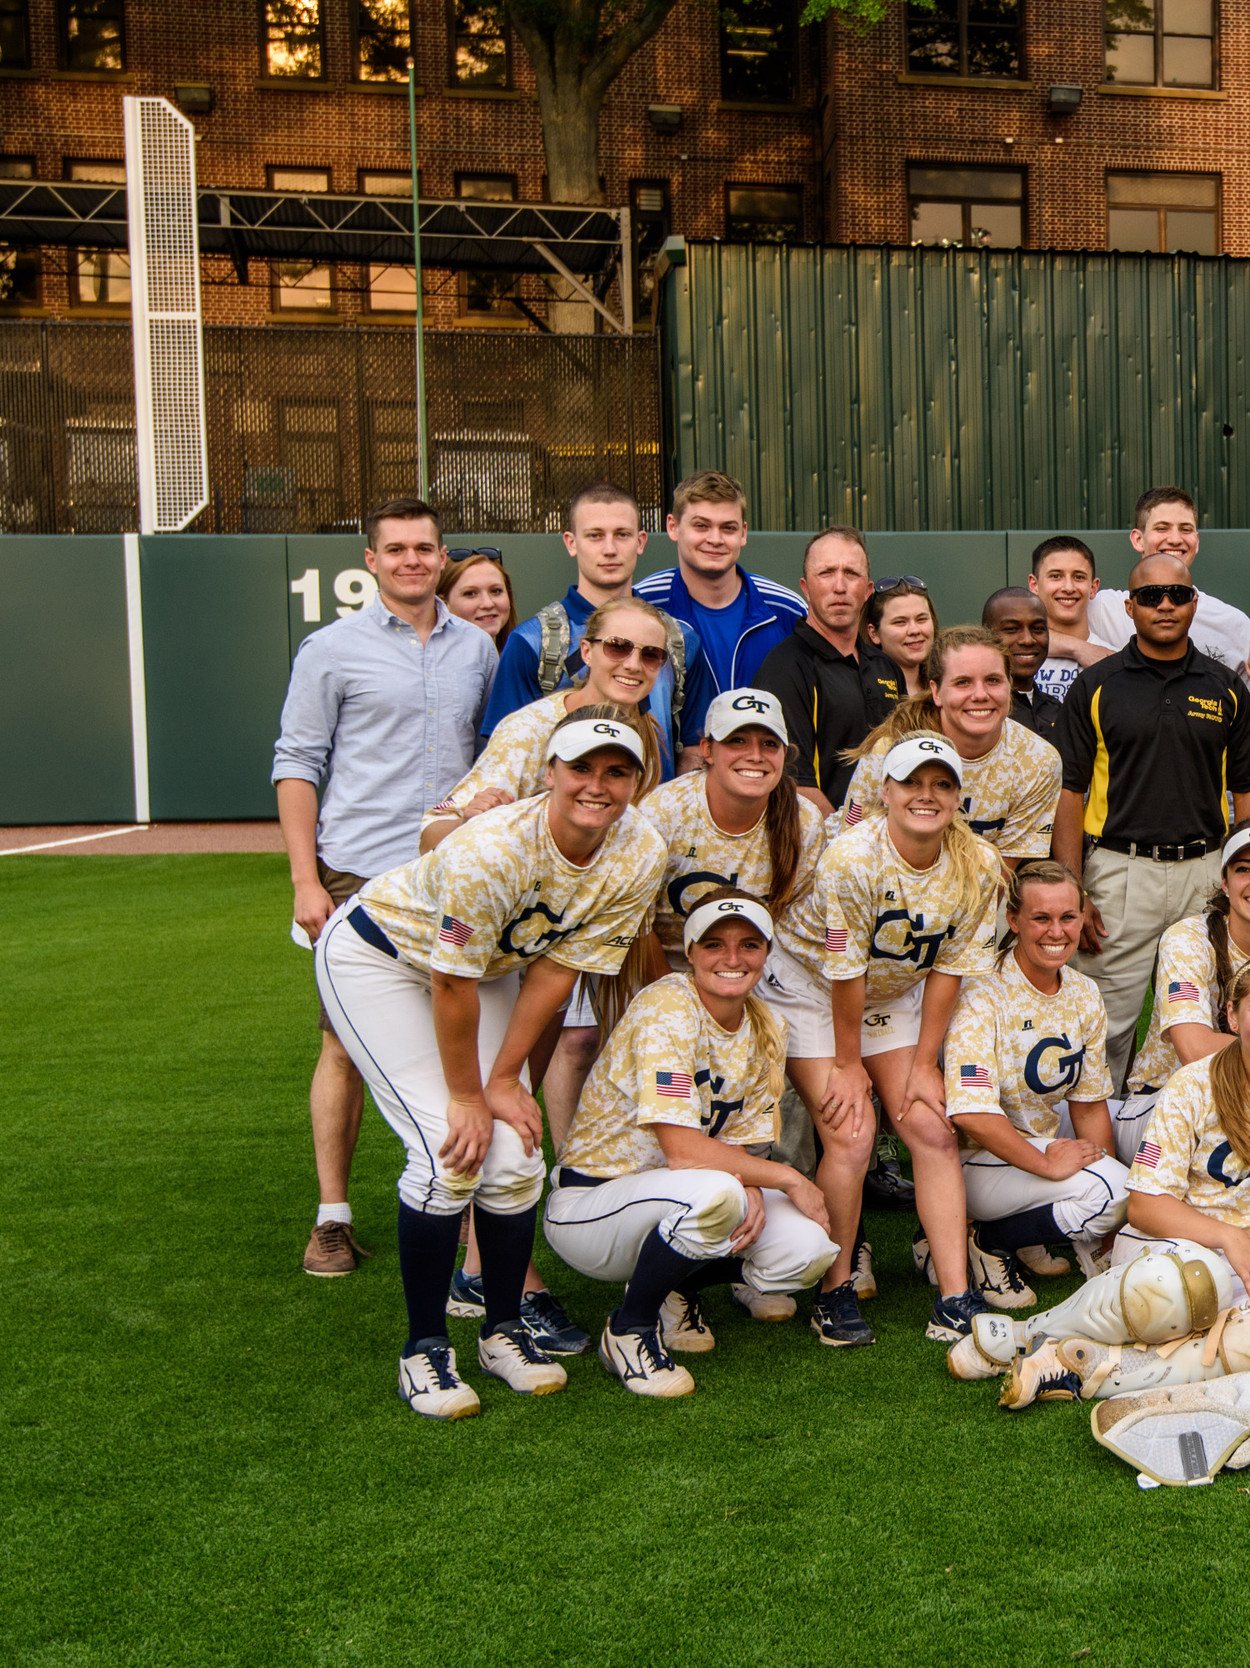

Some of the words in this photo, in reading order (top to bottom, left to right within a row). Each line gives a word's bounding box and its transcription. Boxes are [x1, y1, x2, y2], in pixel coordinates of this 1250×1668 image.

[732, 695, 770, 714] GT
[1188, 695, 1218, 706] Georgia
[1202, 704, 1218, 712] Tech
[593, 723, 620, 738] GT
[919, 741, 943, 755] GT
[718, 902, 744, 912] GT
[871, 909, 957, 972] GT
[864, 1014, 890, 1027] GT
